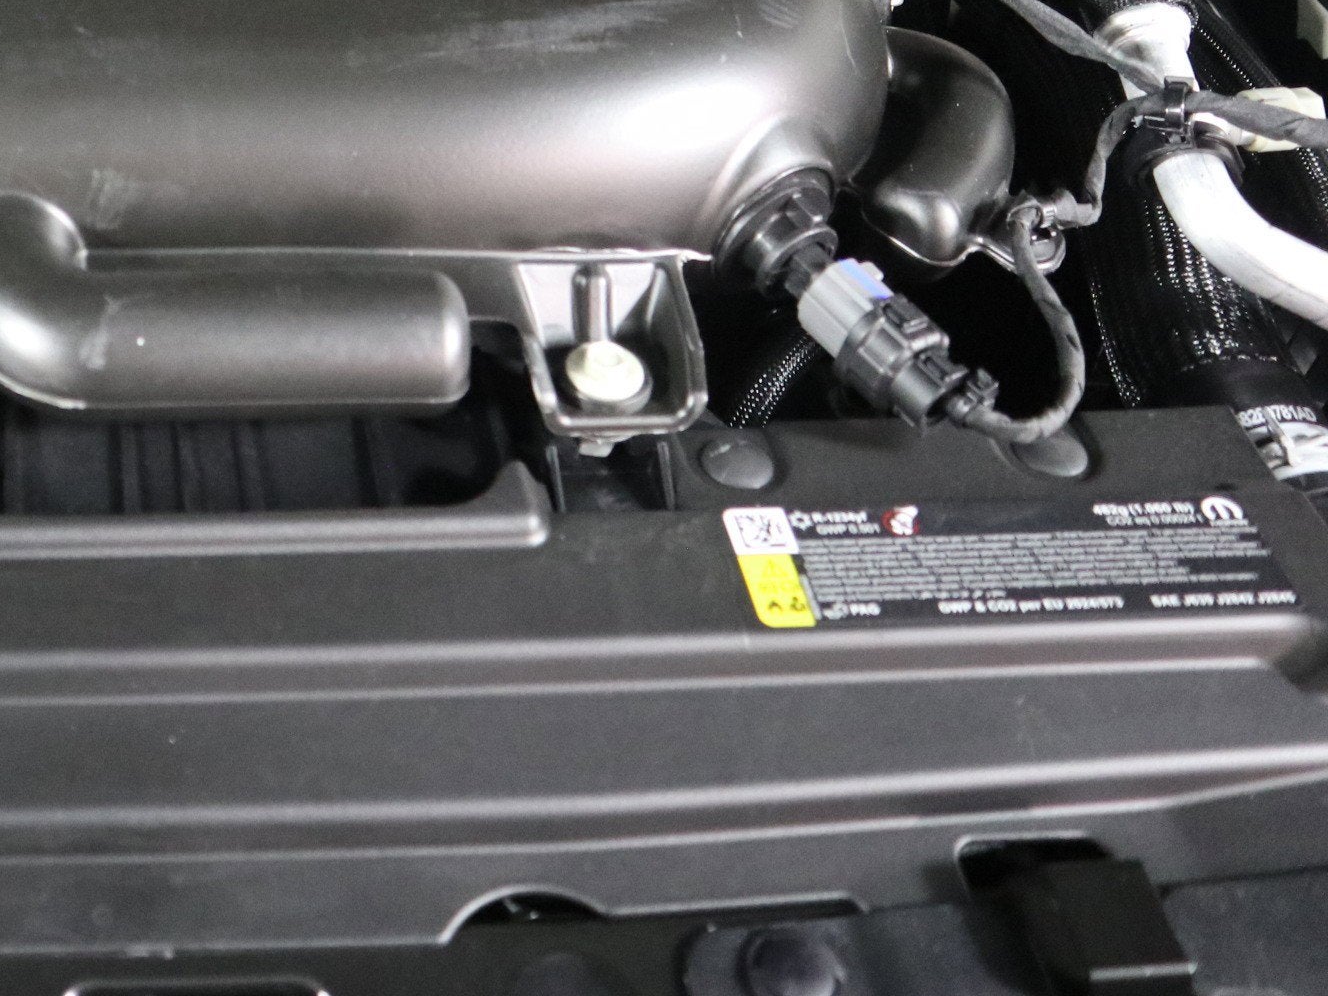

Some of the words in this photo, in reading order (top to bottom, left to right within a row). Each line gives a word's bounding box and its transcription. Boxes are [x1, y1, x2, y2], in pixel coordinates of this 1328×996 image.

[938, 600, 973, 614] GWP
[986, 599, 1018, 612] CO2
[1041, 597, 1065, 611] EU
[1150, 593, 1182, 608] SAE
[849, 602, 882, 616] PAG
